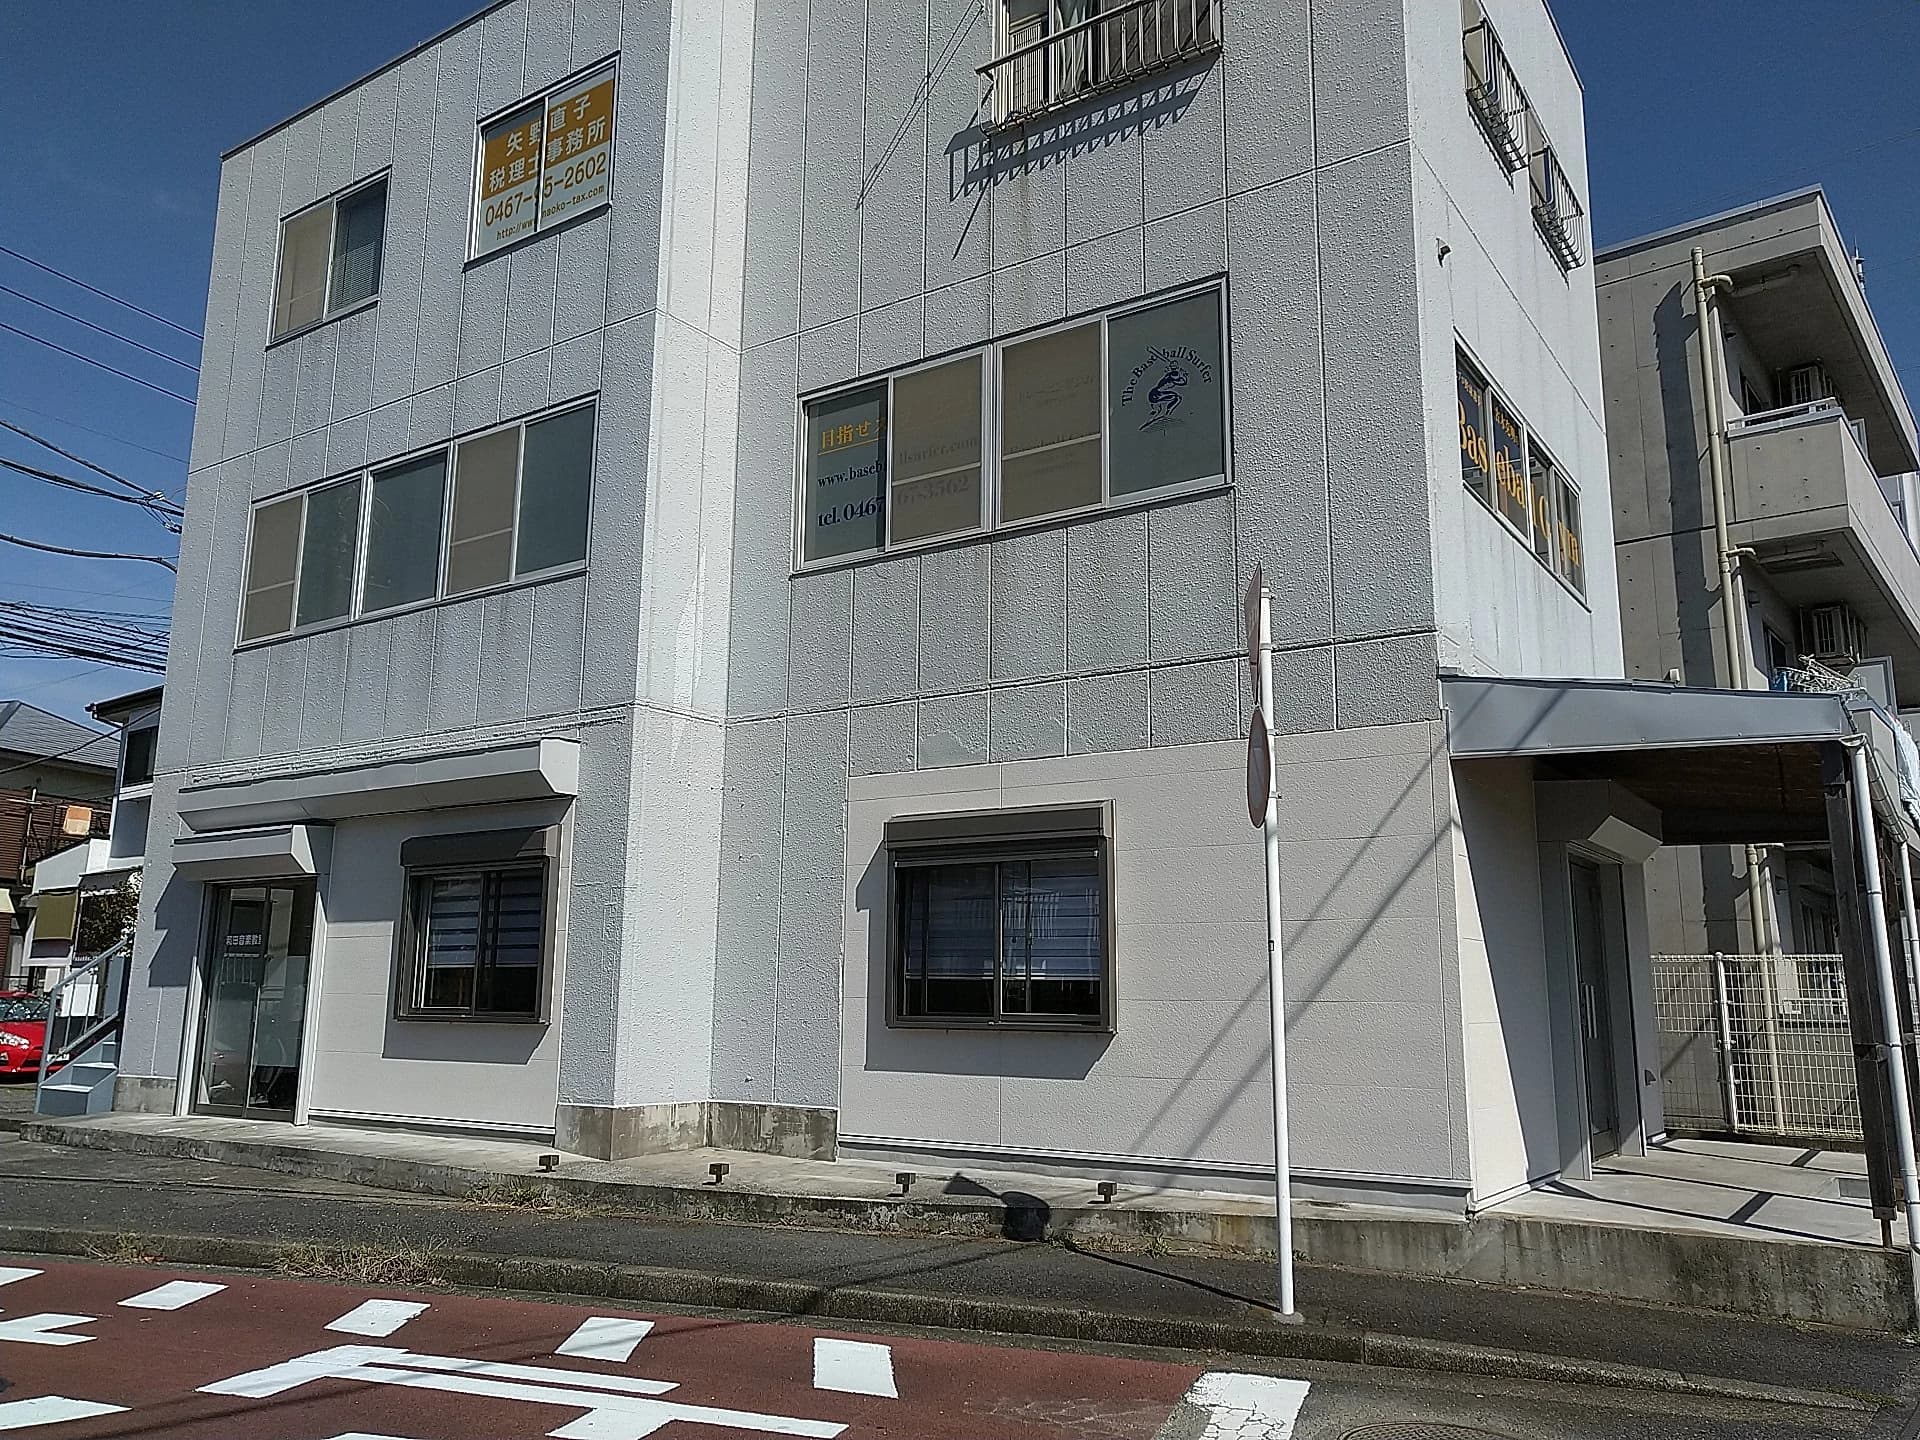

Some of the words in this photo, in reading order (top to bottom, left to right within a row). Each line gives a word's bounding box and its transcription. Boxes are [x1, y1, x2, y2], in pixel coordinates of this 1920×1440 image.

[488, 115, 606, 193] 税理士事務所
[496, 185, 605, 240] http://wwnaoko-tax.com
[1122, 377, 1138, 407] The
[1132, 346, 1187, 379] Baseball
[1185, 349, 1213, 384] Surfer
[1458, 399, 1539, 529] Basebal
